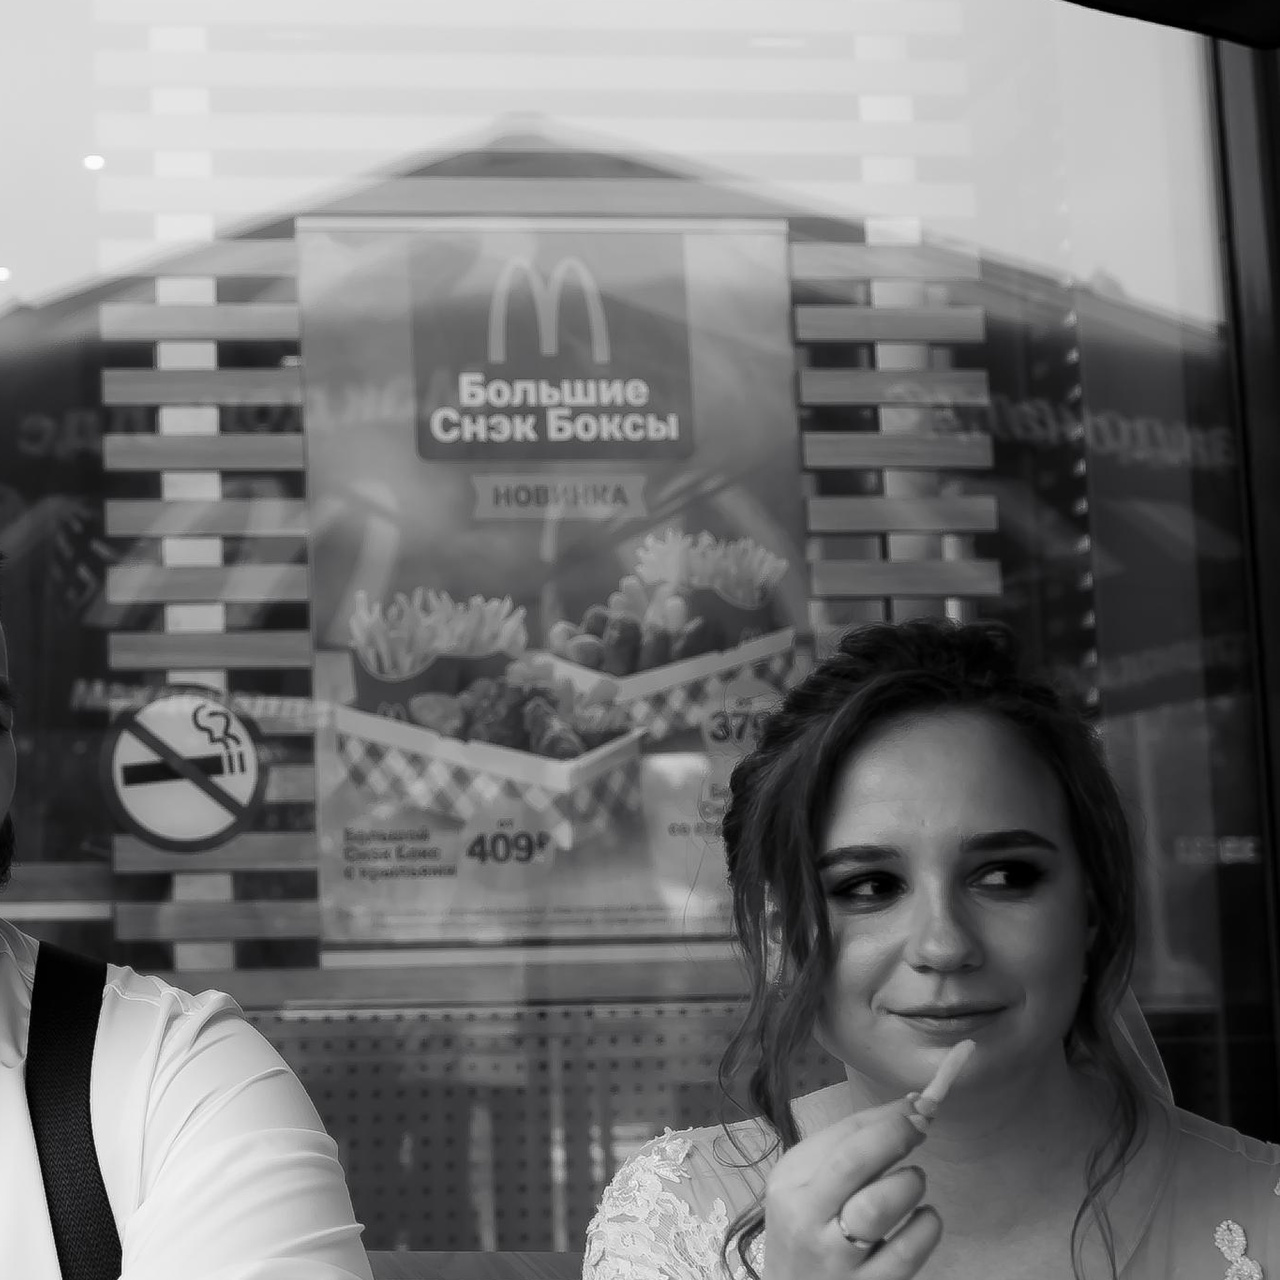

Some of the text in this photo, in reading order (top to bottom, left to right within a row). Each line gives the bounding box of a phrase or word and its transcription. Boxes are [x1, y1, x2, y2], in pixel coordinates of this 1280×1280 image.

[458, 372, 650, 408] Большие
[429, 406, 539, 443] Снэк
[545, 407, 680, 442] Боксы
[492, 484, 629, 507] НОВИНКА
